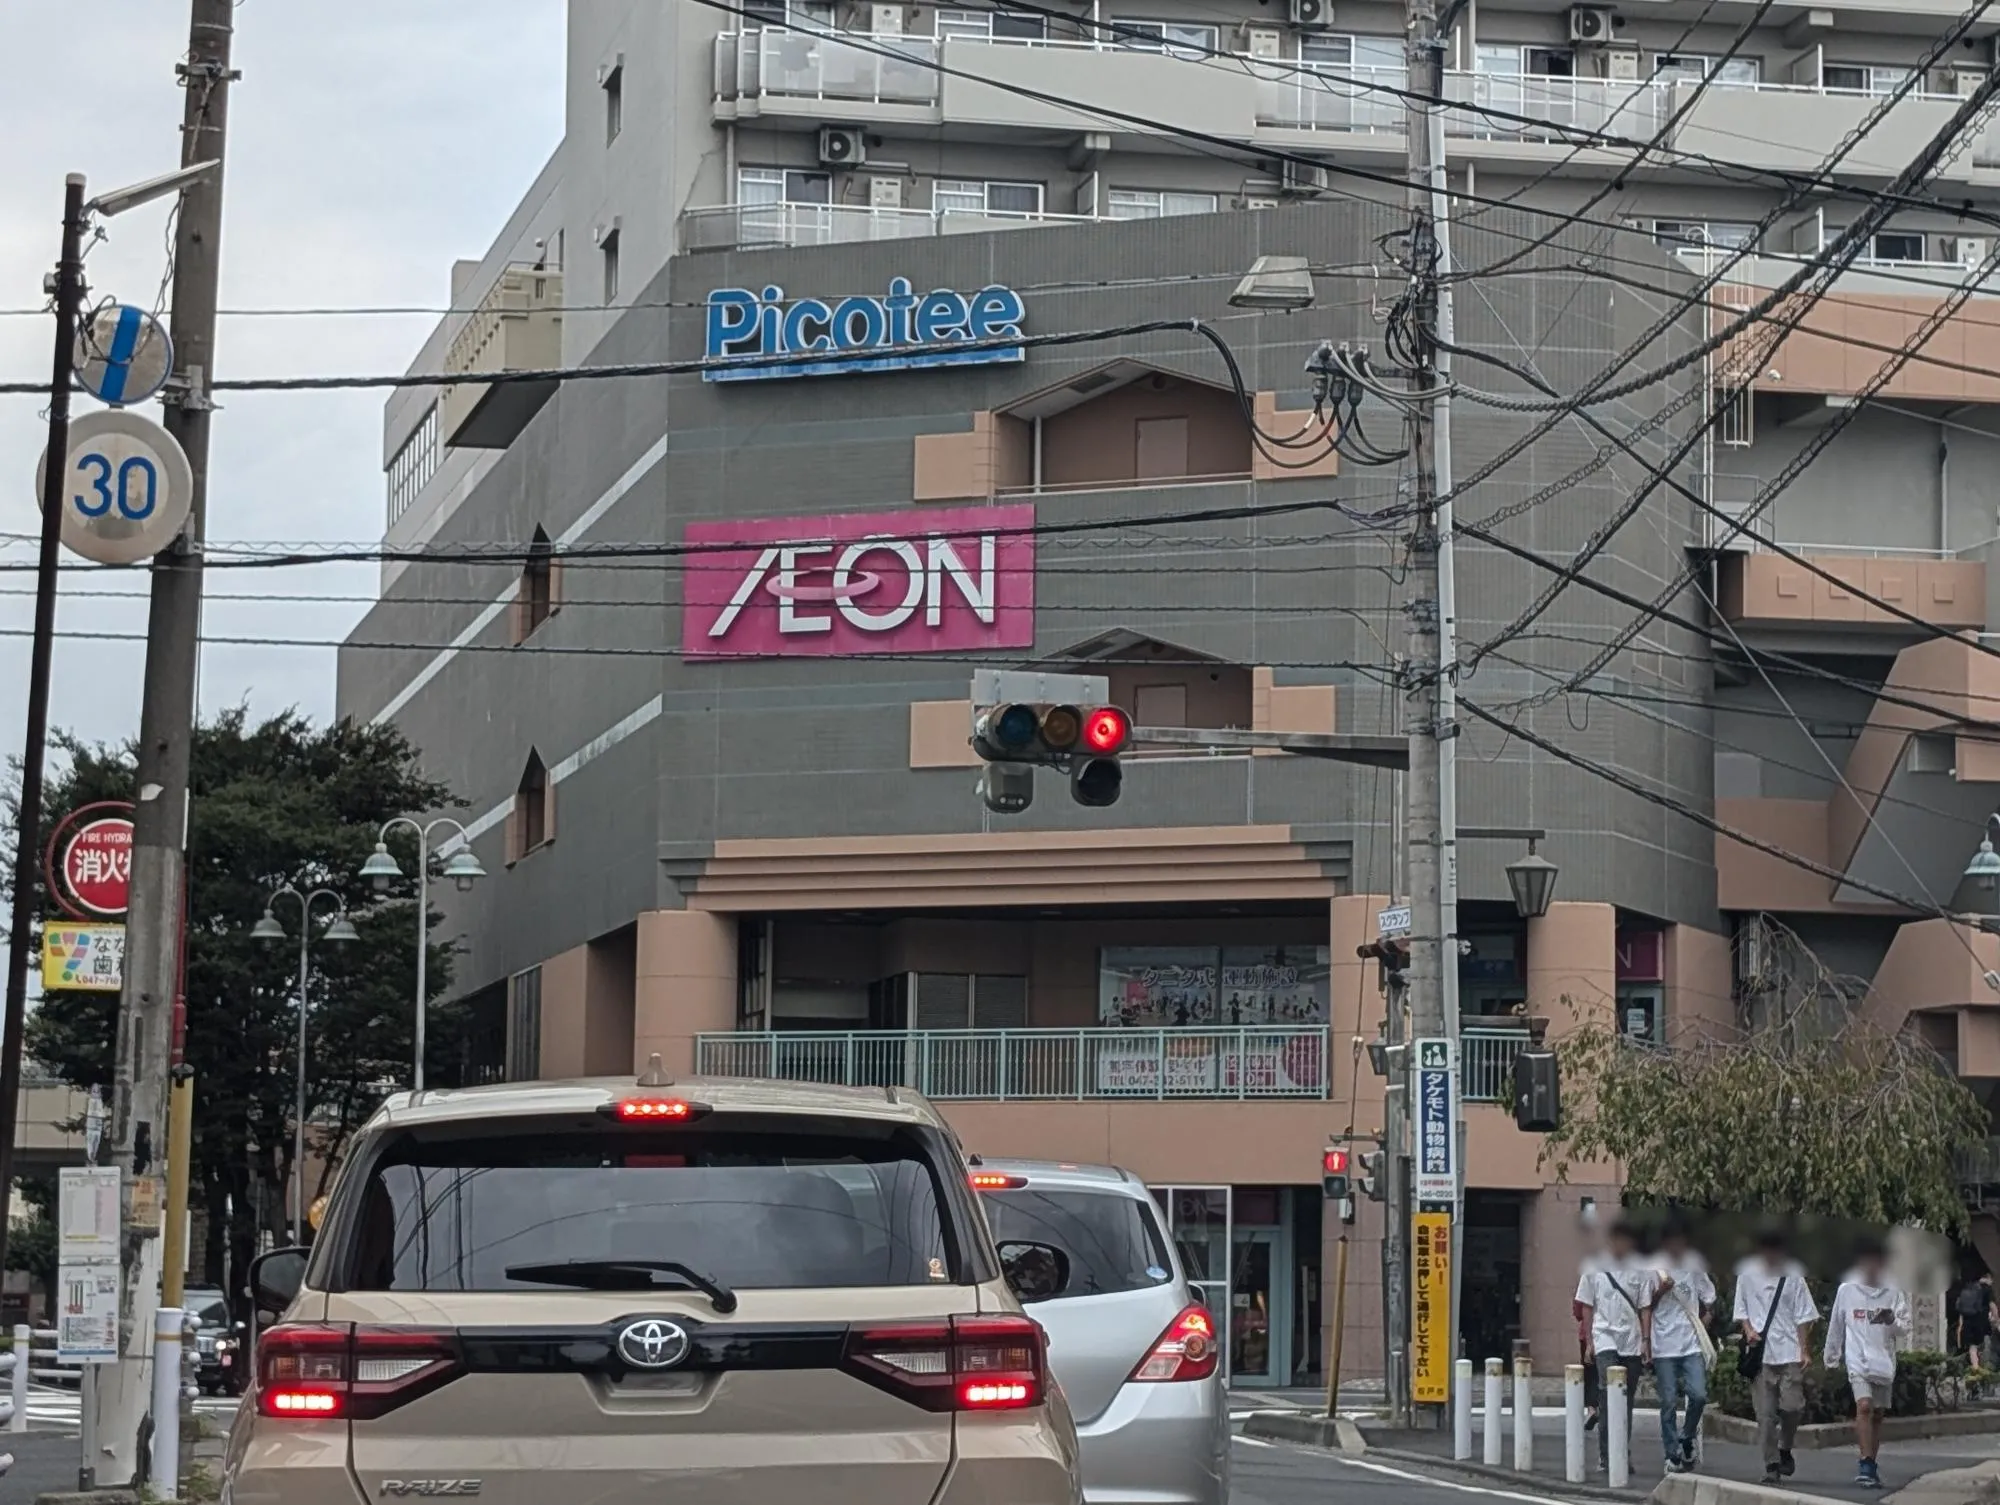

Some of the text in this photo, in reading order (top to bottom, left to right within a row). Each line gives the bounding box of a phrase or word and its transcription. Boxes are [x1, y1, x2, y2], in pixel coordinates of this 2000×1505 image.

[706, 277, 1025, 357] Picotee
[74, 453, 157, 520] 30
[82, 832, 101, 843] FIRE
[1425, 1072, 1446, 1173] タケモト動物病院
[379, 1478, 483, 1498] RAIZE
